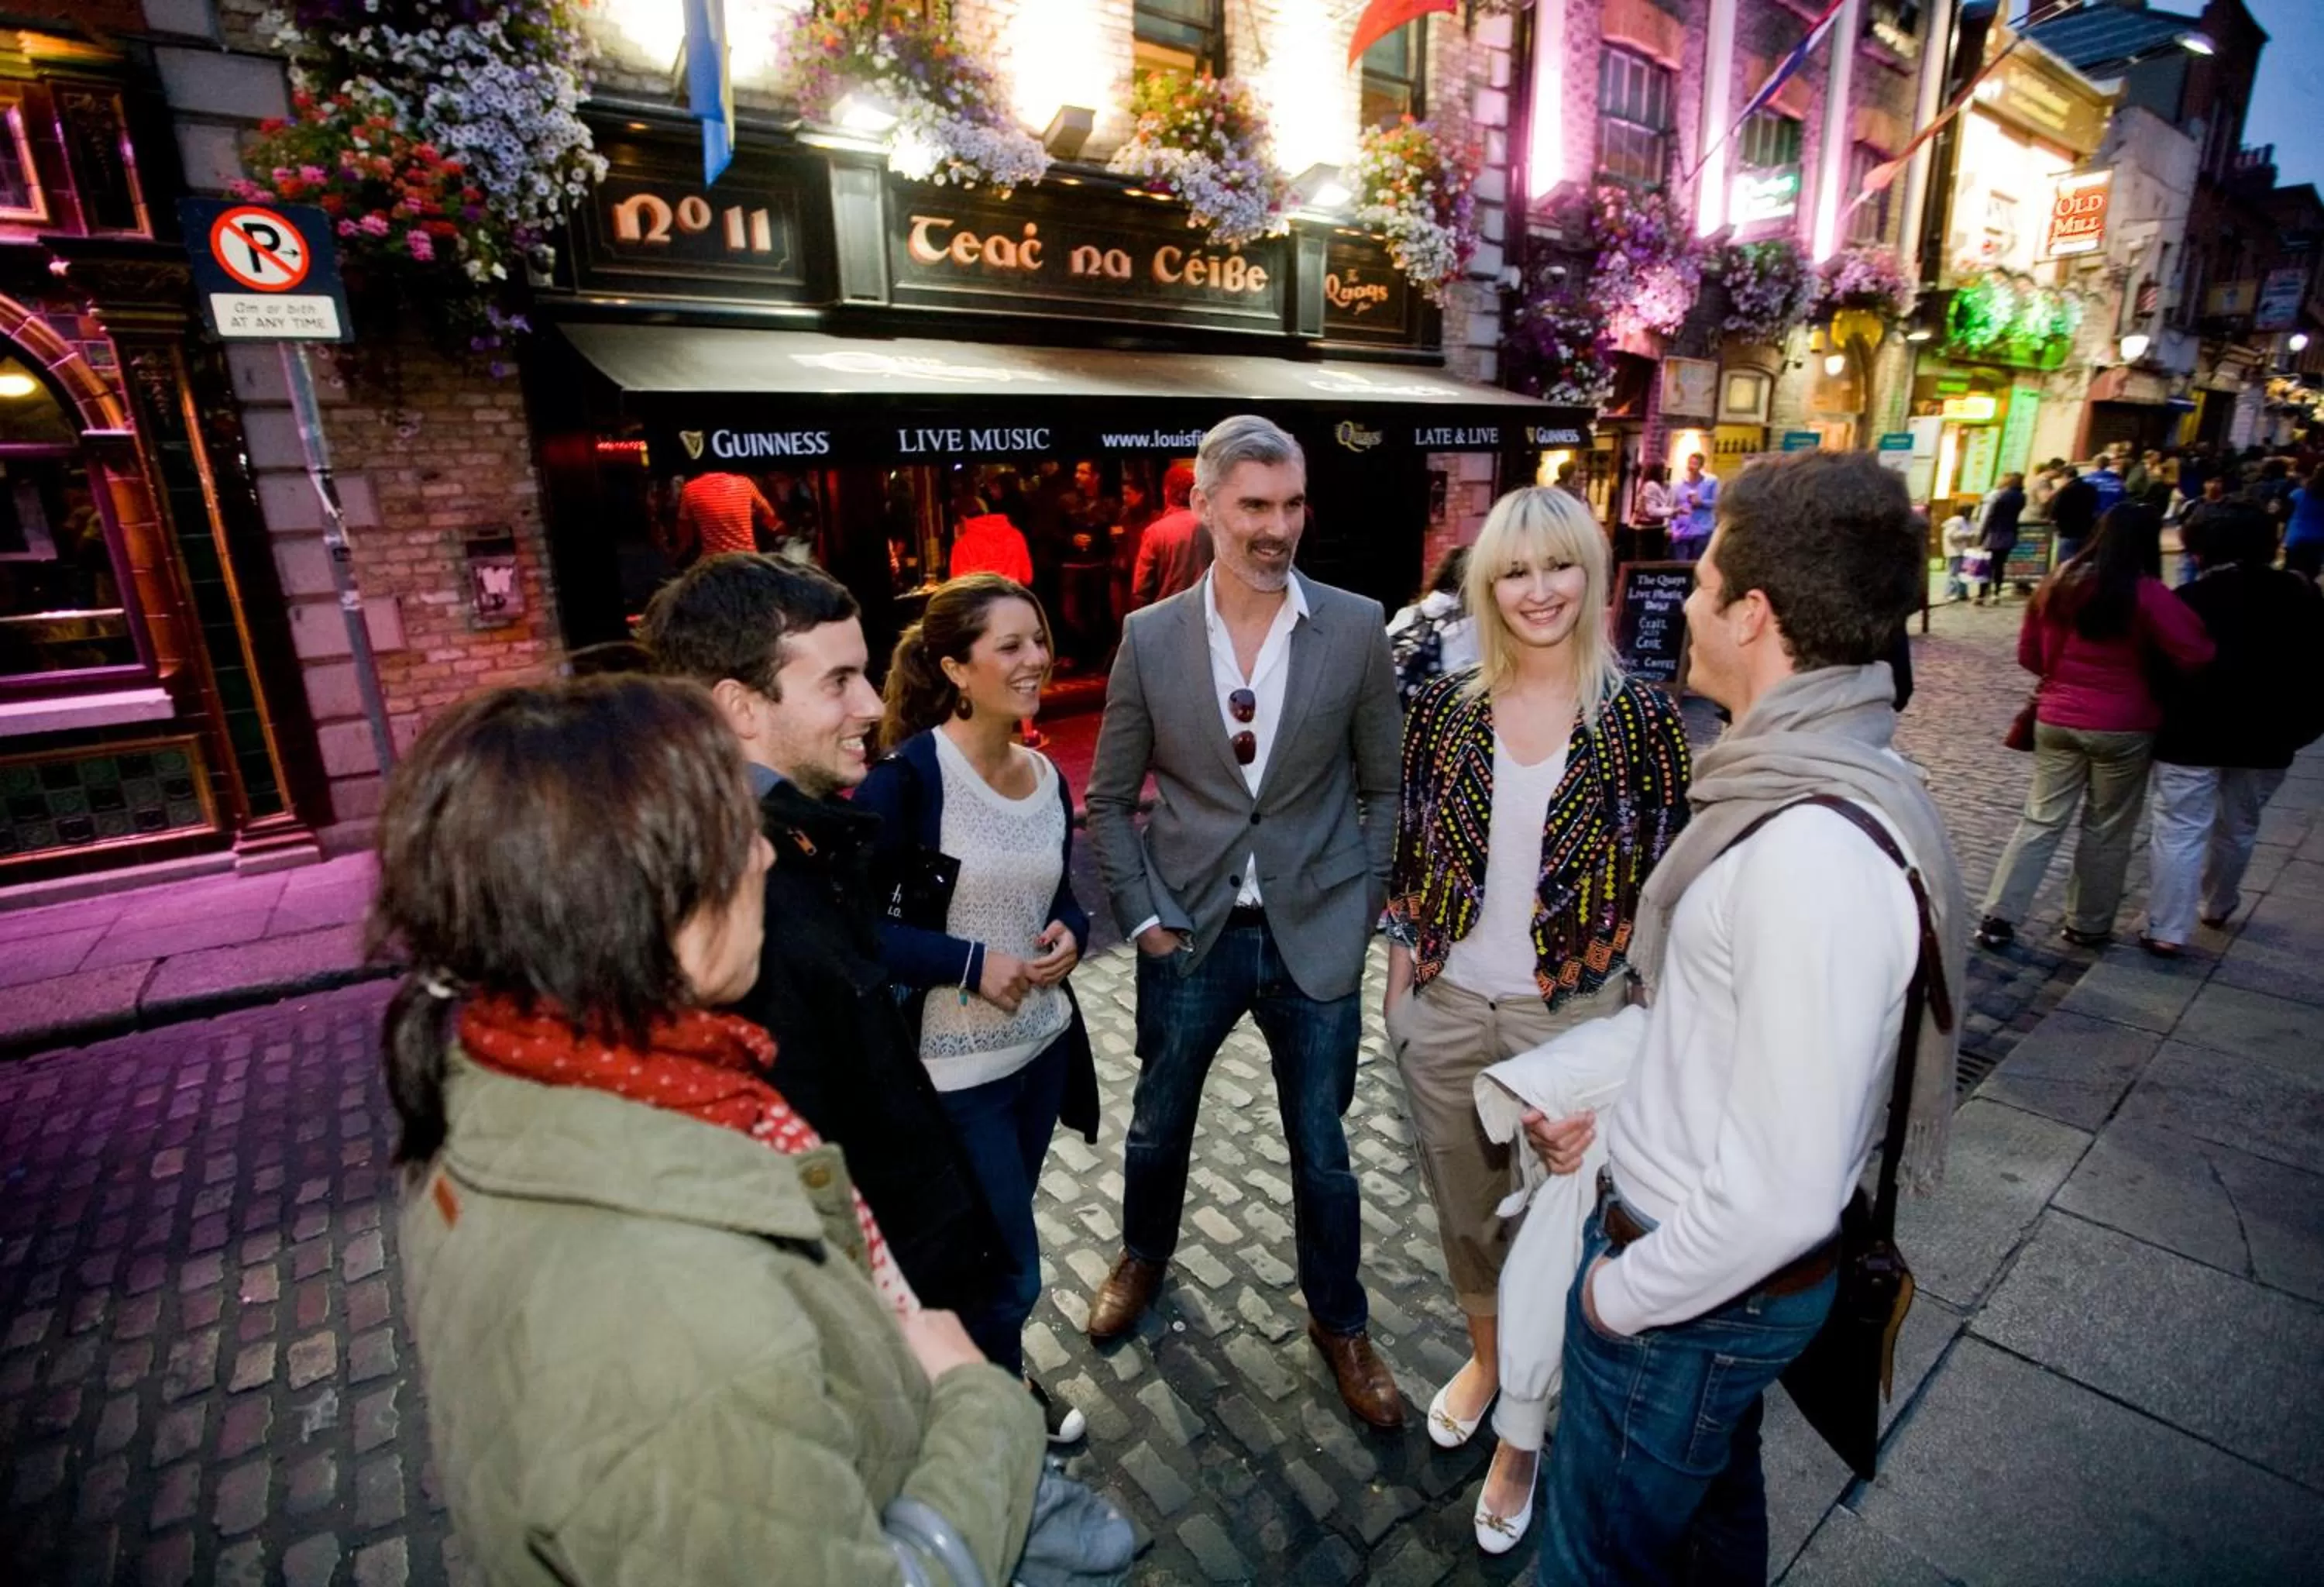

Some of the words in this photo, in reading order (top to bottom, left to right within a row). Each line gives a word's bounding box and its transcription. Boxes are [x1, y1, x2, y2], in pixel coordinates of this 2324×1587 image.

[2055, 194, 2105, 217] OLD
[1069, 244, 1132, 279] na
[231, 316, 248, 328] AT
[256, 317, 285, 329] ANY
[292, 318, 326, 330] TIME
[712, 429, 830, 458] GUINNESS
[898, 429, 964, 452] LIVE
[969, 428, 1050, 451] MUSIC
[1415, 428, 1452, 445] LATE
[1454, 428, 1466, 444] &
[1468, 428, 1499, 444] LIVE
